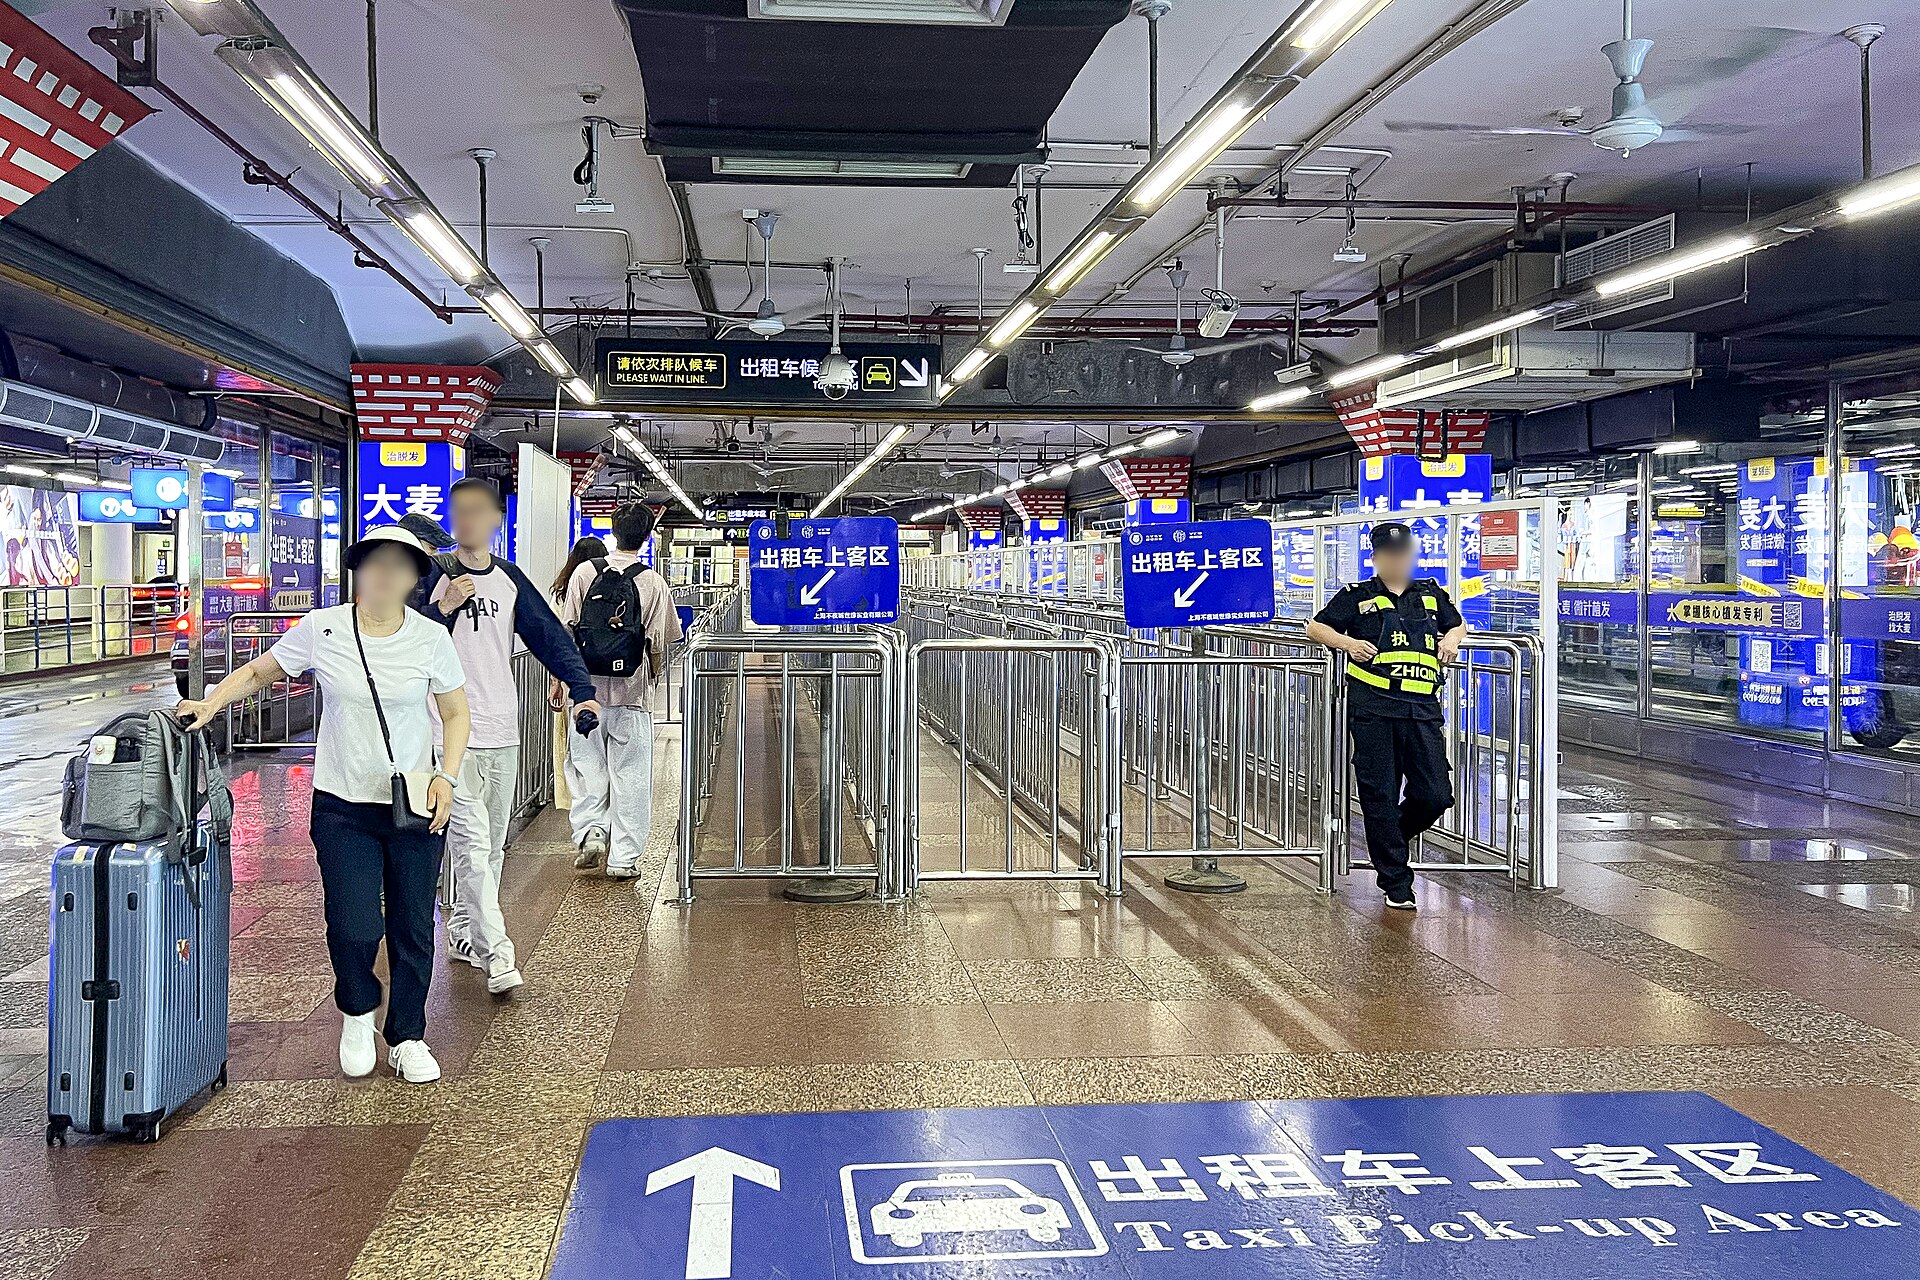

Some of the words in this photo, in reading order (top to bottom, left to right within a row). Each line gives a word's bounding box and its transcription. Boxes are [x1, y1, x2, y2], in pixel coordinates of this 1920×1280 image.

[616, 357, 718, 373] 请依次排队候车
[740, 358, 859, 378] 出租车候区
[616, 374, 649, 383] PLEASE
[650, 374, 674, 383] WAIT
[675, 375, 685, 383] IN
[686, 375, 708, 384] LINE.
[386, 451, 420, 463] 治脱发
[363, 484, 444, 521] 大麦
[759, 546, 890, 569] 出租车上客区
[1131, 547, 1264, 574] 出租车上客区
[1088, 1141, 1822, 1202] 出租车上客区
[1113, 1216, 1316, 1252] Taxi
[1323, 1210, 1678, 1248] Pick-up
[1699, 1203, 1902, 1233] Area
